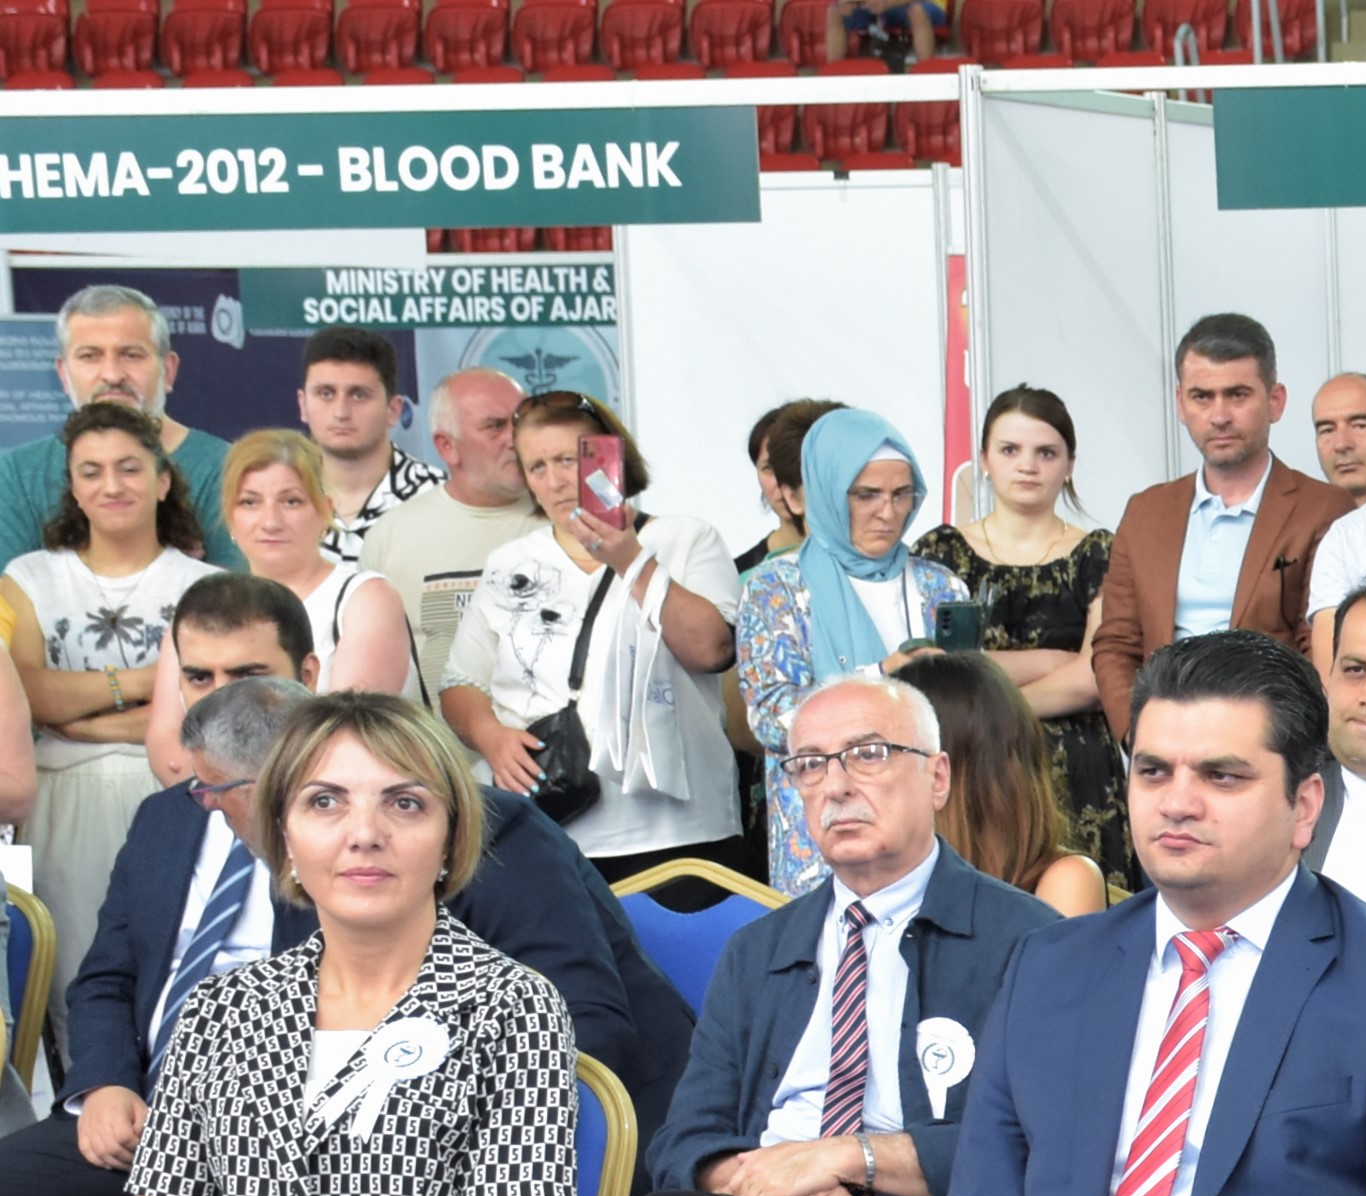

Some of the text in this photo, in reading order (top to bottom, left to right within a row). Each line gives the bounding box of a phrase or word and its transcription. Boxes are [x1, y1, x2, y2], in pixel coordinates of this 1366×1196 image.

[338, 144, 520, 192] BLOOD
[531, 141, 683, 189] BANK
[325, 266, 611, 295] MINISTRY OF HEALTH &
[303, 297, 398, 324] SOCIAL
[401, 297, 506, 323] AFFAIRS
[509, 296, 543, 322] OF
